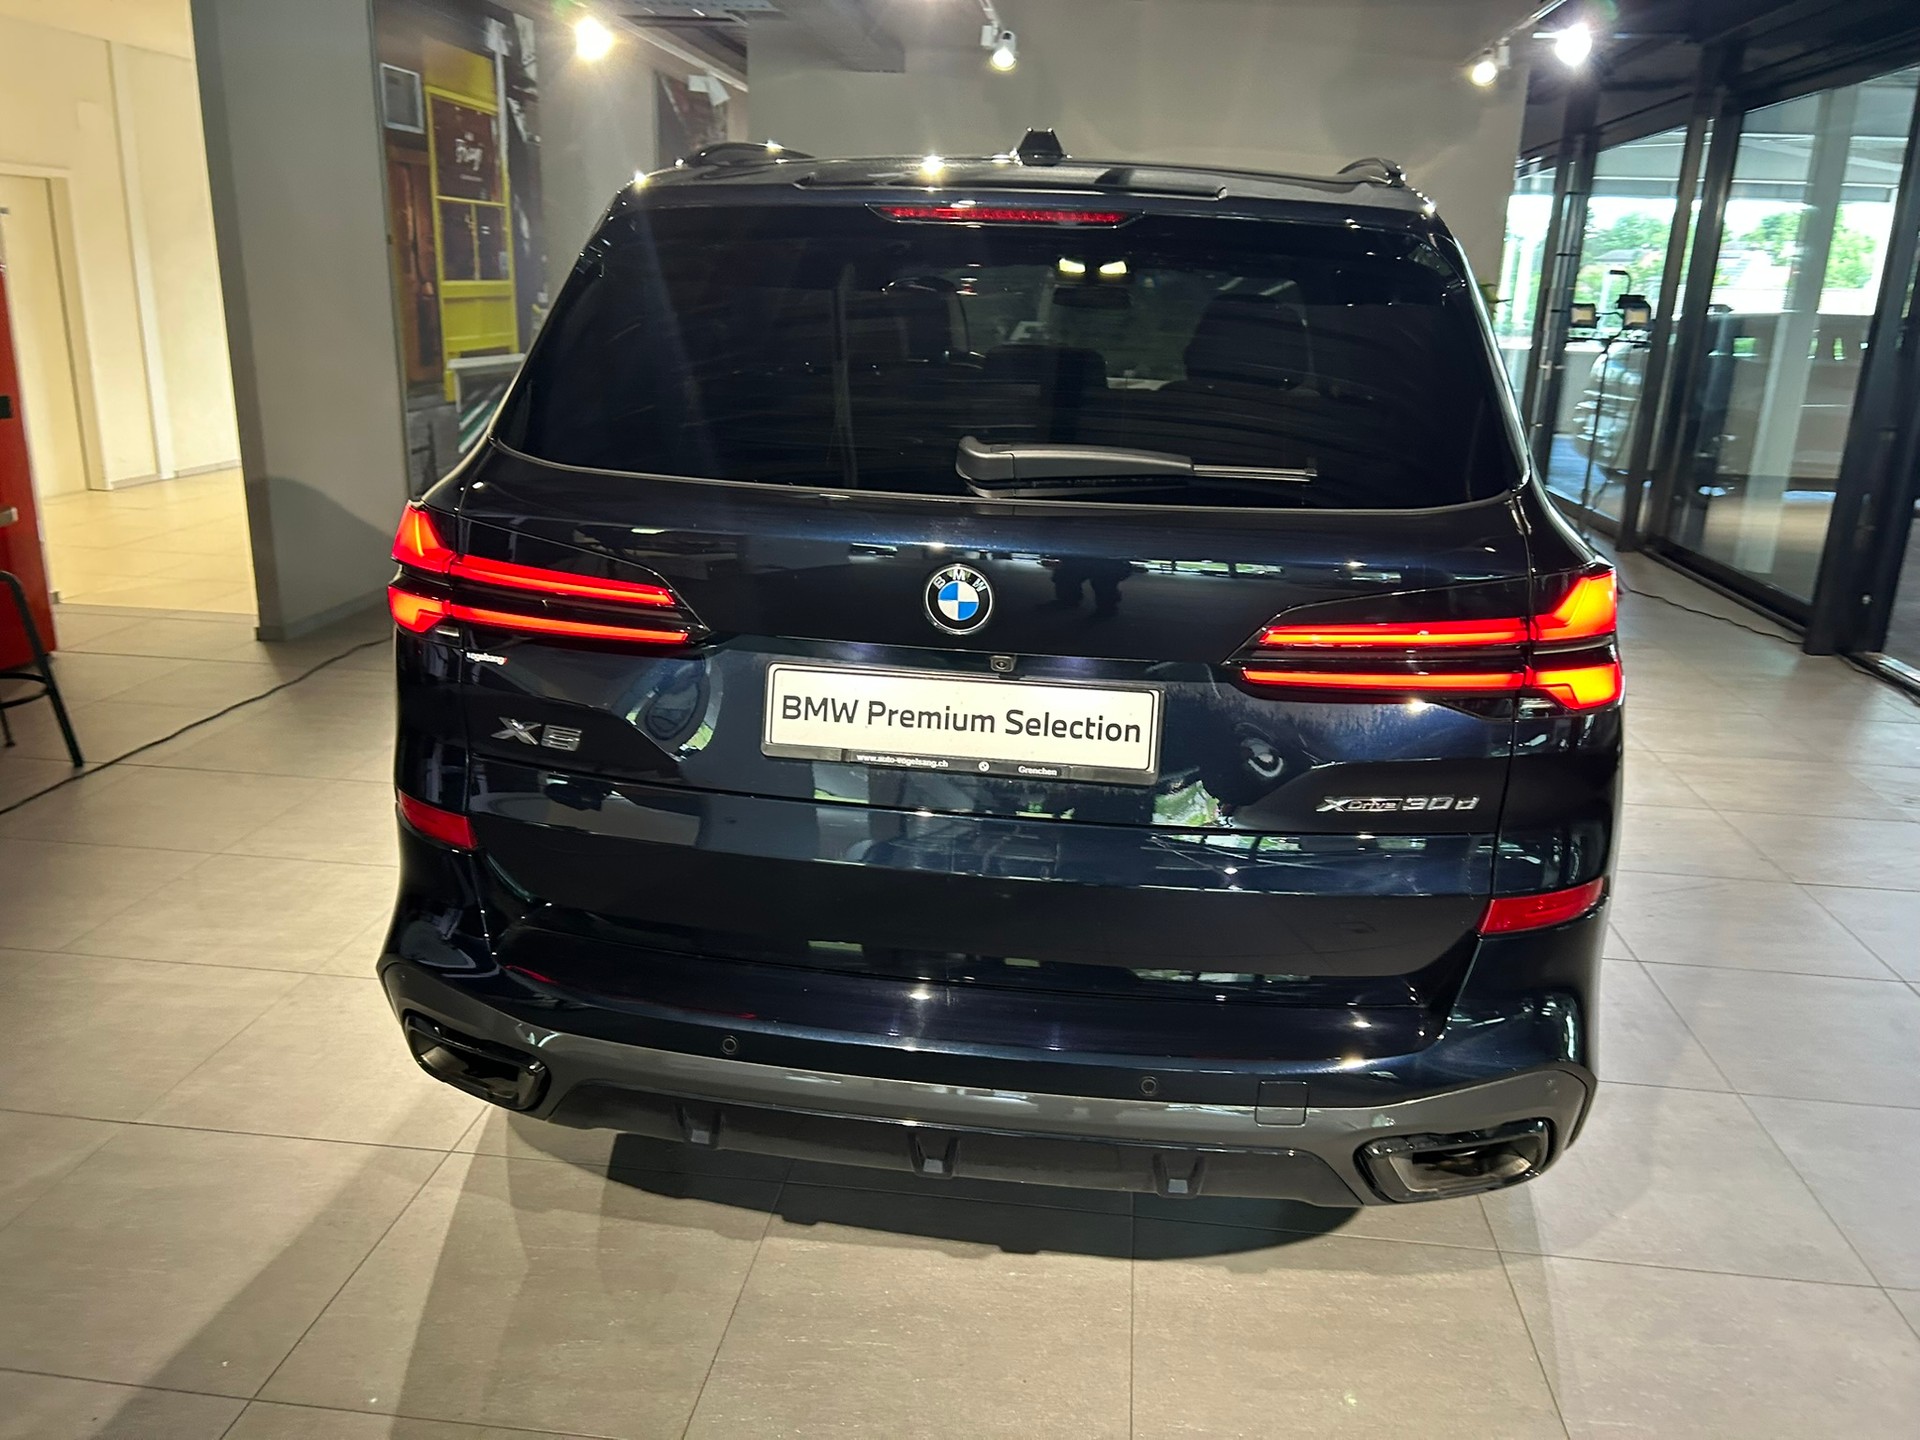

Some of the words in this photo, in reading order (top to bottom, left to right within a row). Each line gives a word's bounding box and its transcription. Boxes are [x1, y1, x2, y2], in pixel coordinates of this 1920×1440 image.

[932, 567, 987, 593] BMW
[781, 694, 859, 725] BMW
[867, 700, 996, 734] Premium
[1005, 709, 1142, 744] Selection
[856, 752, 949, 769] www.auto-vogelsang.ch
[1018, 764, 1058, 776] Grenchen
